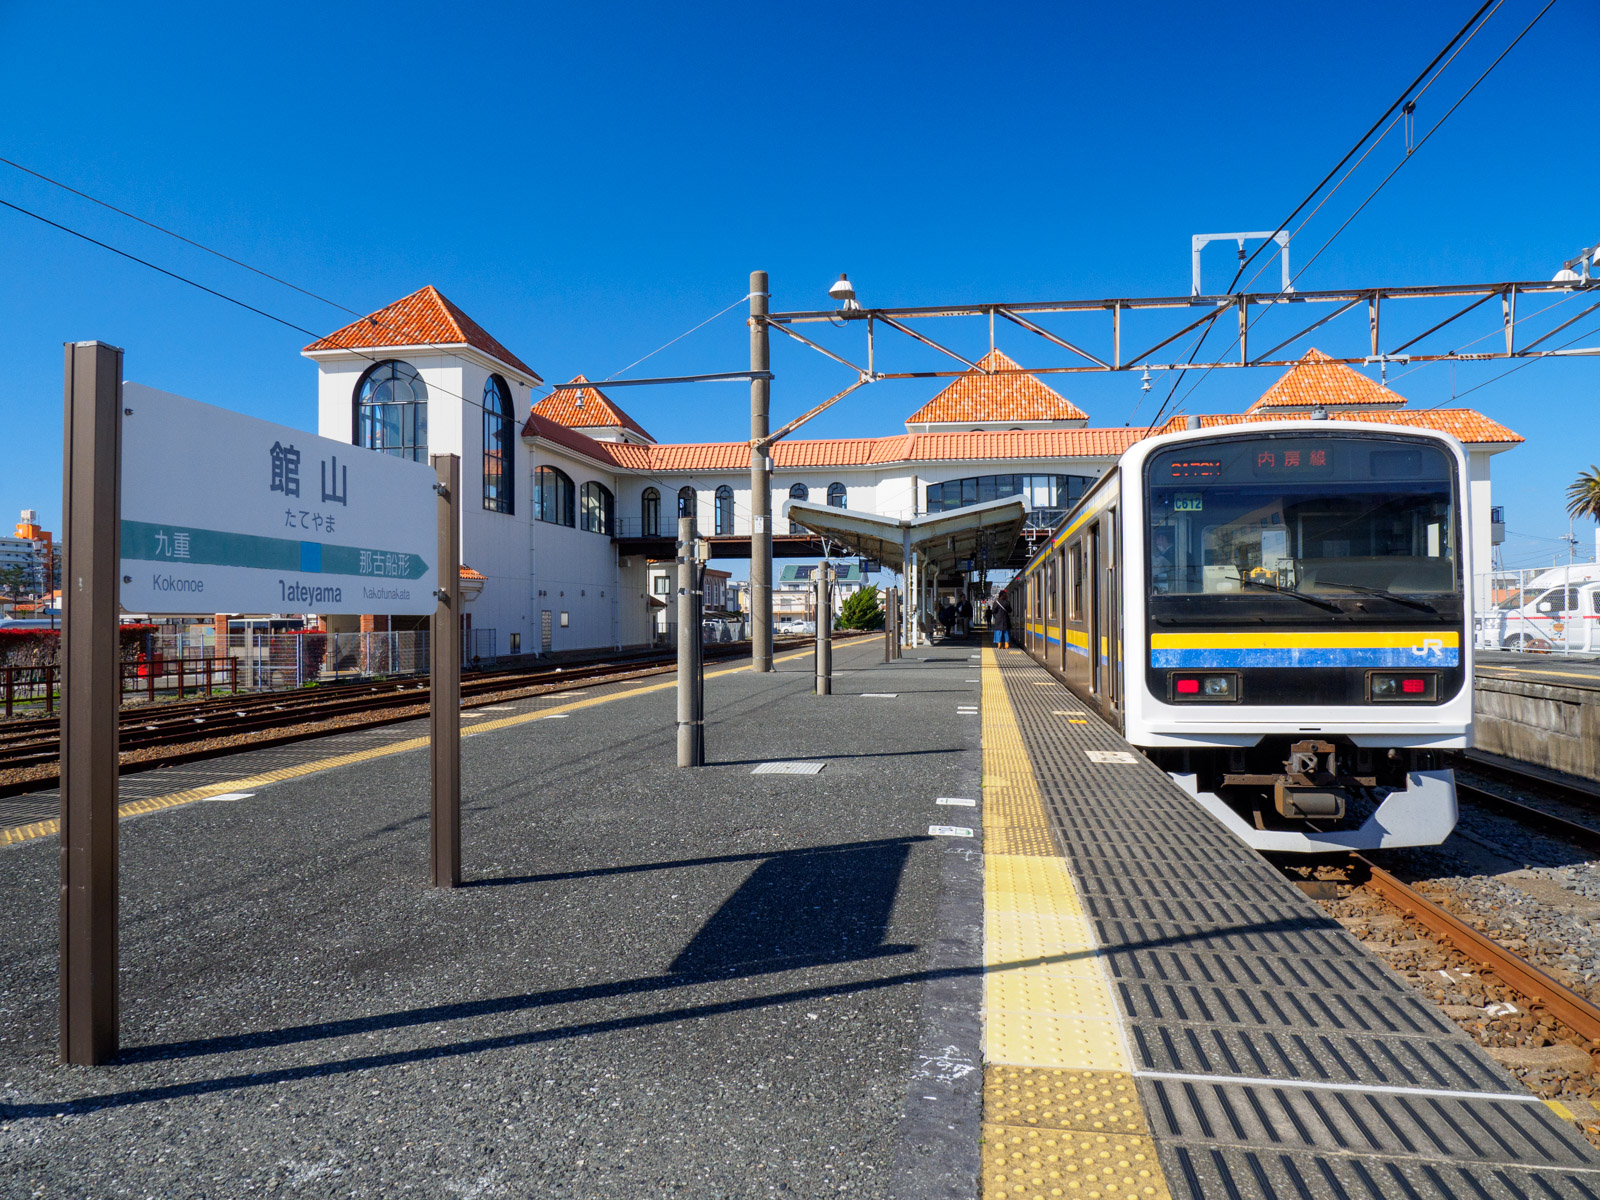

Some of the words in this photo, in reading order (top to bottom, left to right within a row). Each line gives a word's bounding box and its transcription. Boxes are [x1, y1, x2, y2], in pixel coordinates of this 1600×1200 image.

[1258, 450, 1326, 467] 内房線
[1175, 498, 1201, 509] C612
[285, 508, 335, 533] たてやま
[155, 530, 190, 558] 九重
[360, 550, 410, 576] 那古船形
[153, 574, 204, 592] Kokonoe
[279, 580, 342, 606] Tateyama
[1412, 639, 1442, 658] JR
